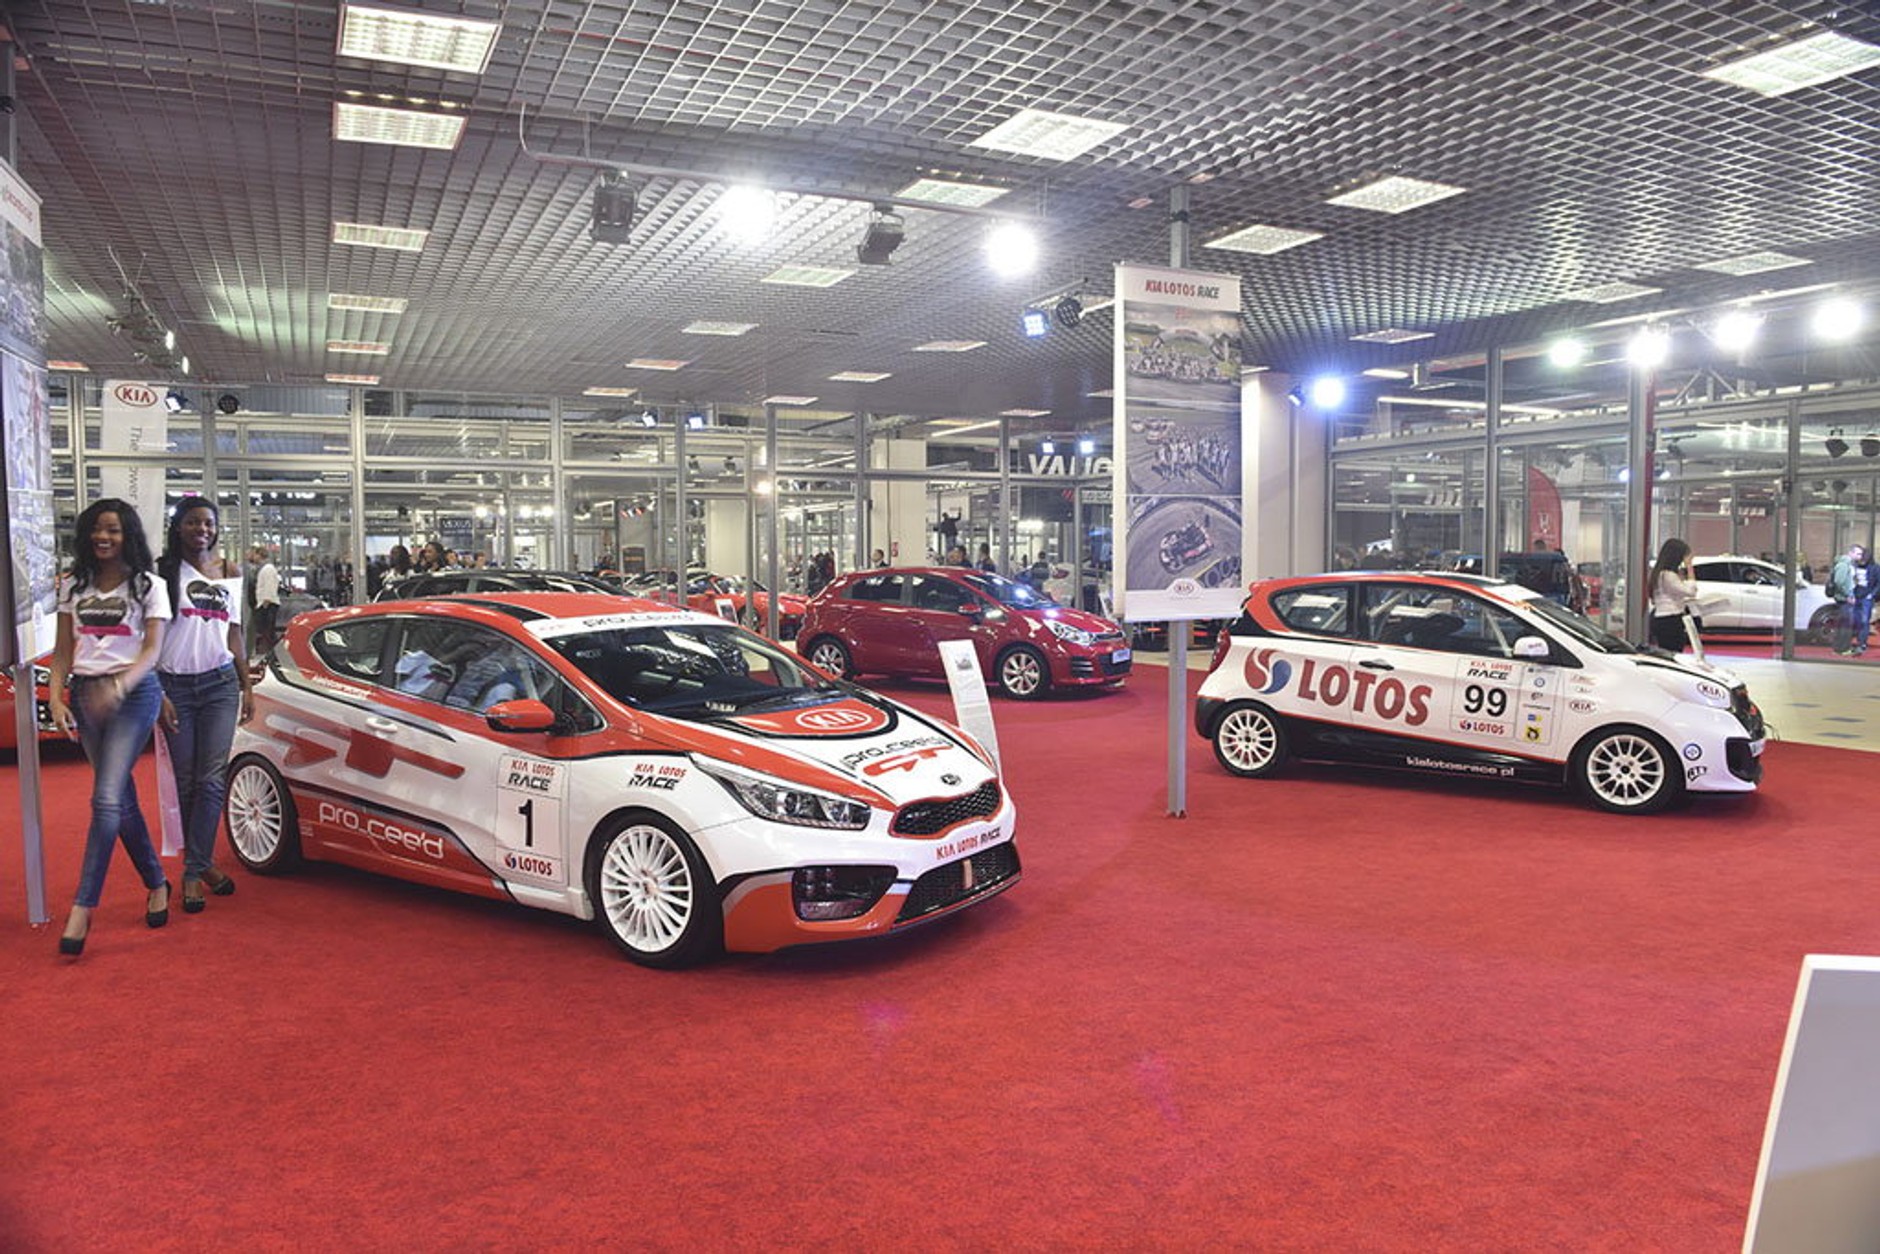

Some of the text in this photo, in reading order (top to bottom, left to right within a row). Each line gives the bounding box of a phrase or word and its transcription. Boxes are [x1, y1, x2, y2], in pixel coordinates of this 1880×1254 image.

[1145, 280, 1220, 299] KIA LOTOS RACE
[122, 387, 150, 403] KIA
[129, 426, 142, 451] The
[1467, 668, 1509, 680] RACE
[1470, 660, 1513, 671] KIA LOTOS
[1298, 659, 1432, 726] LOTOS
[1464, 684, 1507, 717] 99
[803, 711, 866, 727] KIA
[1473, 722, 1504, 735] LOTOS
[511, 759, 555, 776] KIA LOTOS
[635, 763, 687, 778] KIA LOTOS
[508, 773, 551, 791] RACE
[629, 774, 680, 791] RACE
[518, 799, 533, 847] 1
[936, 844, 955, 860] KIA
[980, 826, 1001, 845] RACE
[519, 856, 552, 877] LOTOS
